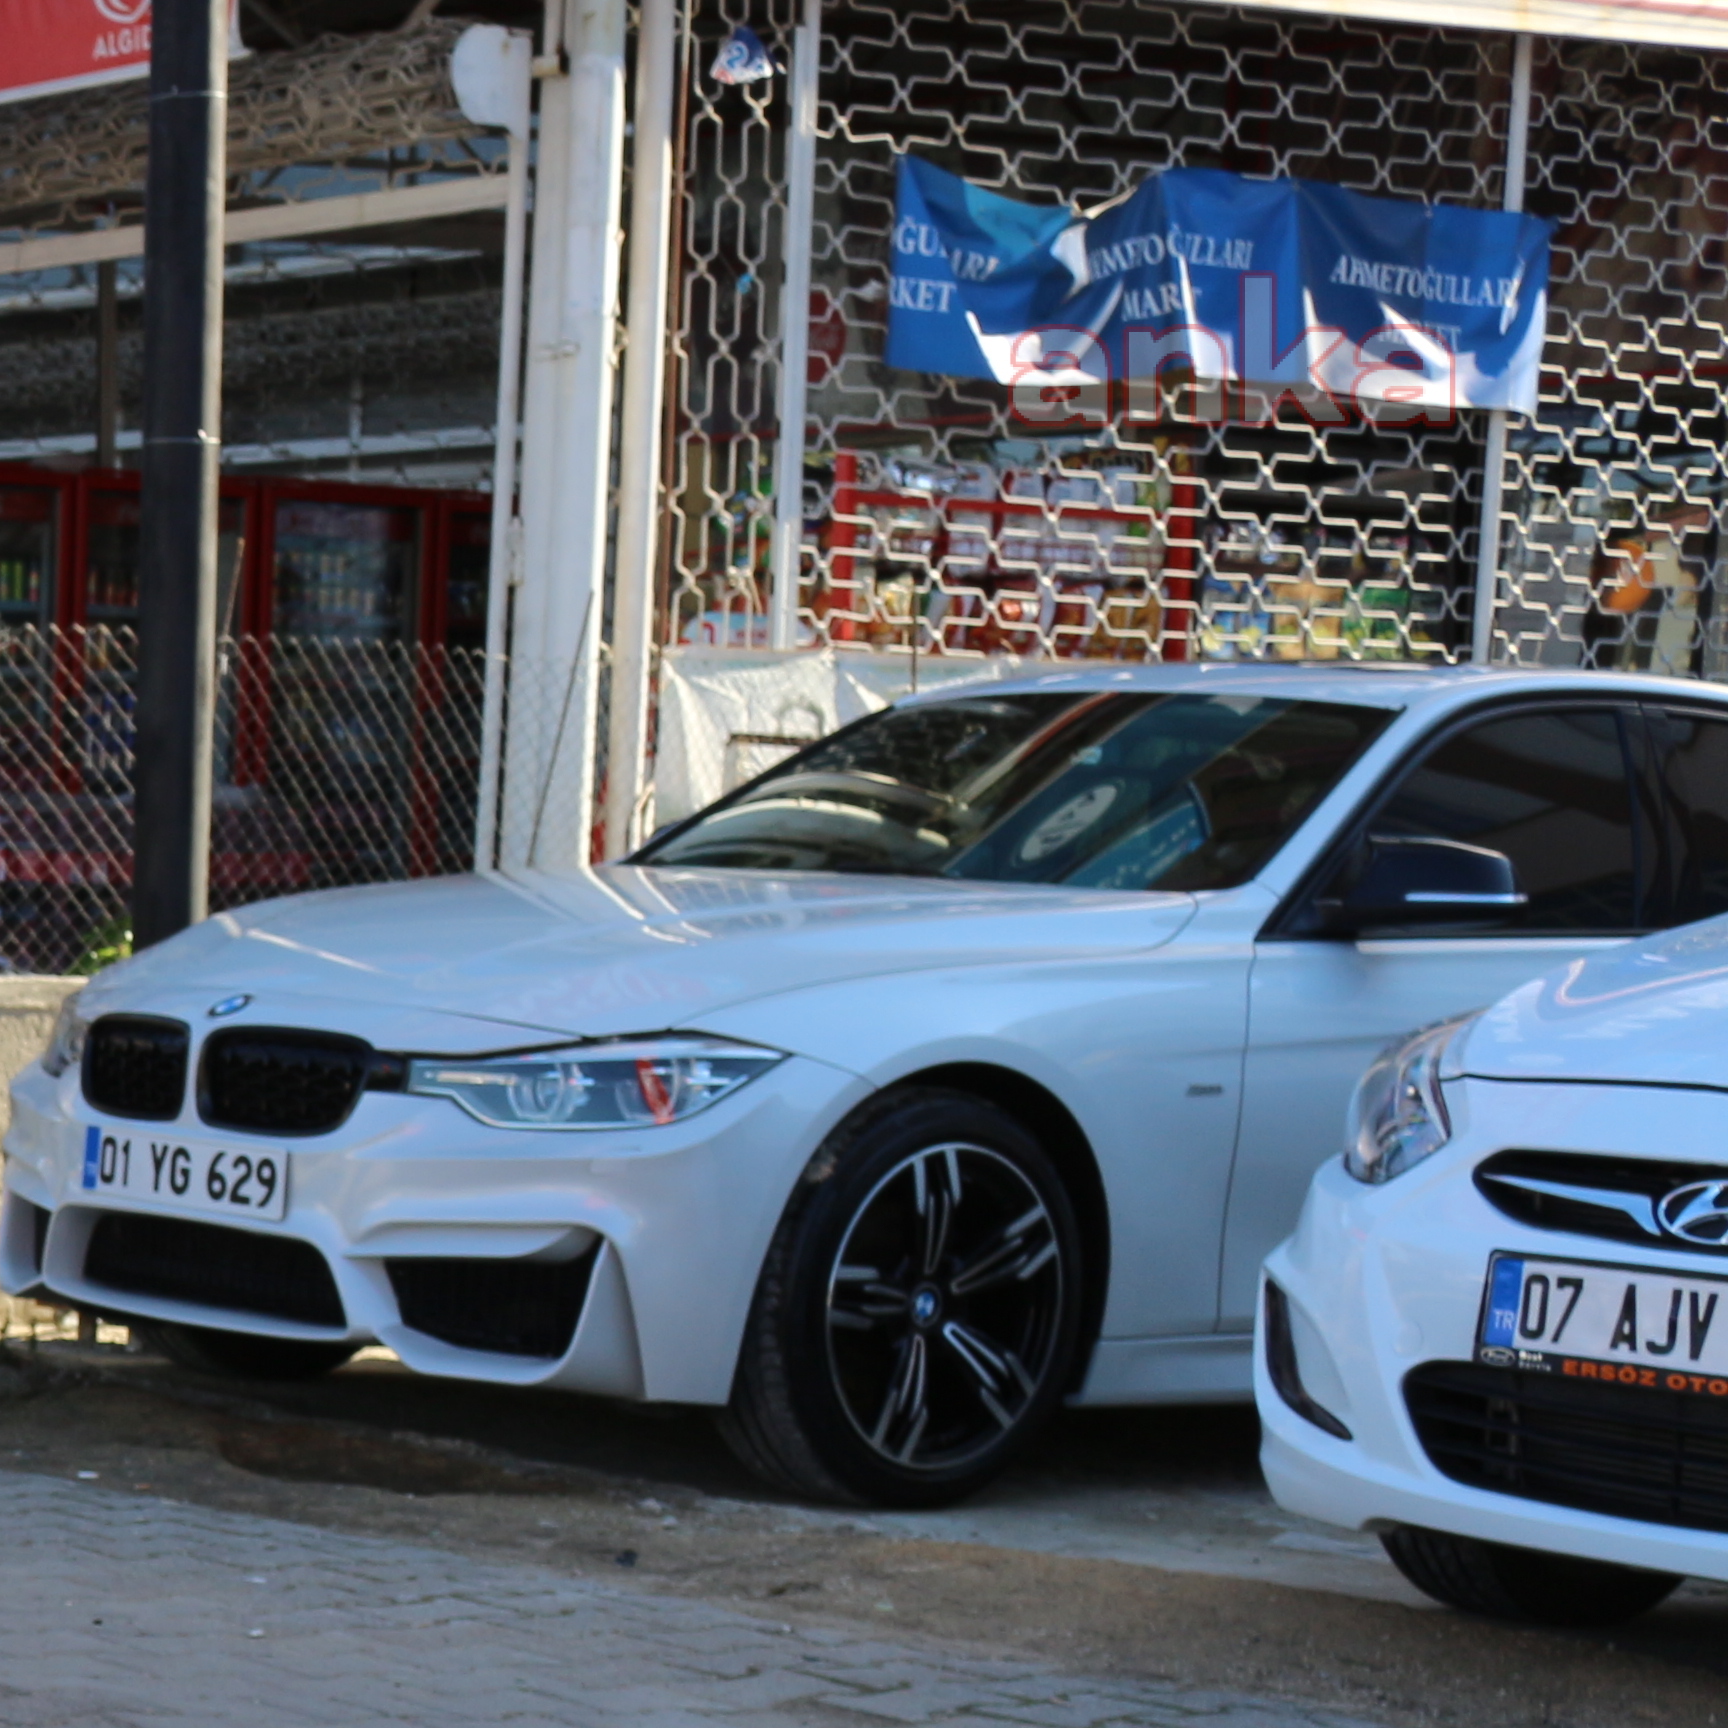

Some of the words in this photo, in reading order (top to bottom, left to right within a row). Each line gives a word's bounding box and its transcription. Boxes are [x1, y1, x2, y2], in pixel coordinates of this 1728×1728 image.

[100, 1136, 132, 1187] 01
[151, 1142, 192, 1195] YG
[207, 1151, 277, 1209] 629
[1493, 1308, 1516, 1331] TR
[1519, 1273, 1585, 1344] 07
[1609, 1283, 1719, 1362] AJV
[1562, 1358, 1658, 1388] ERSÖZ
